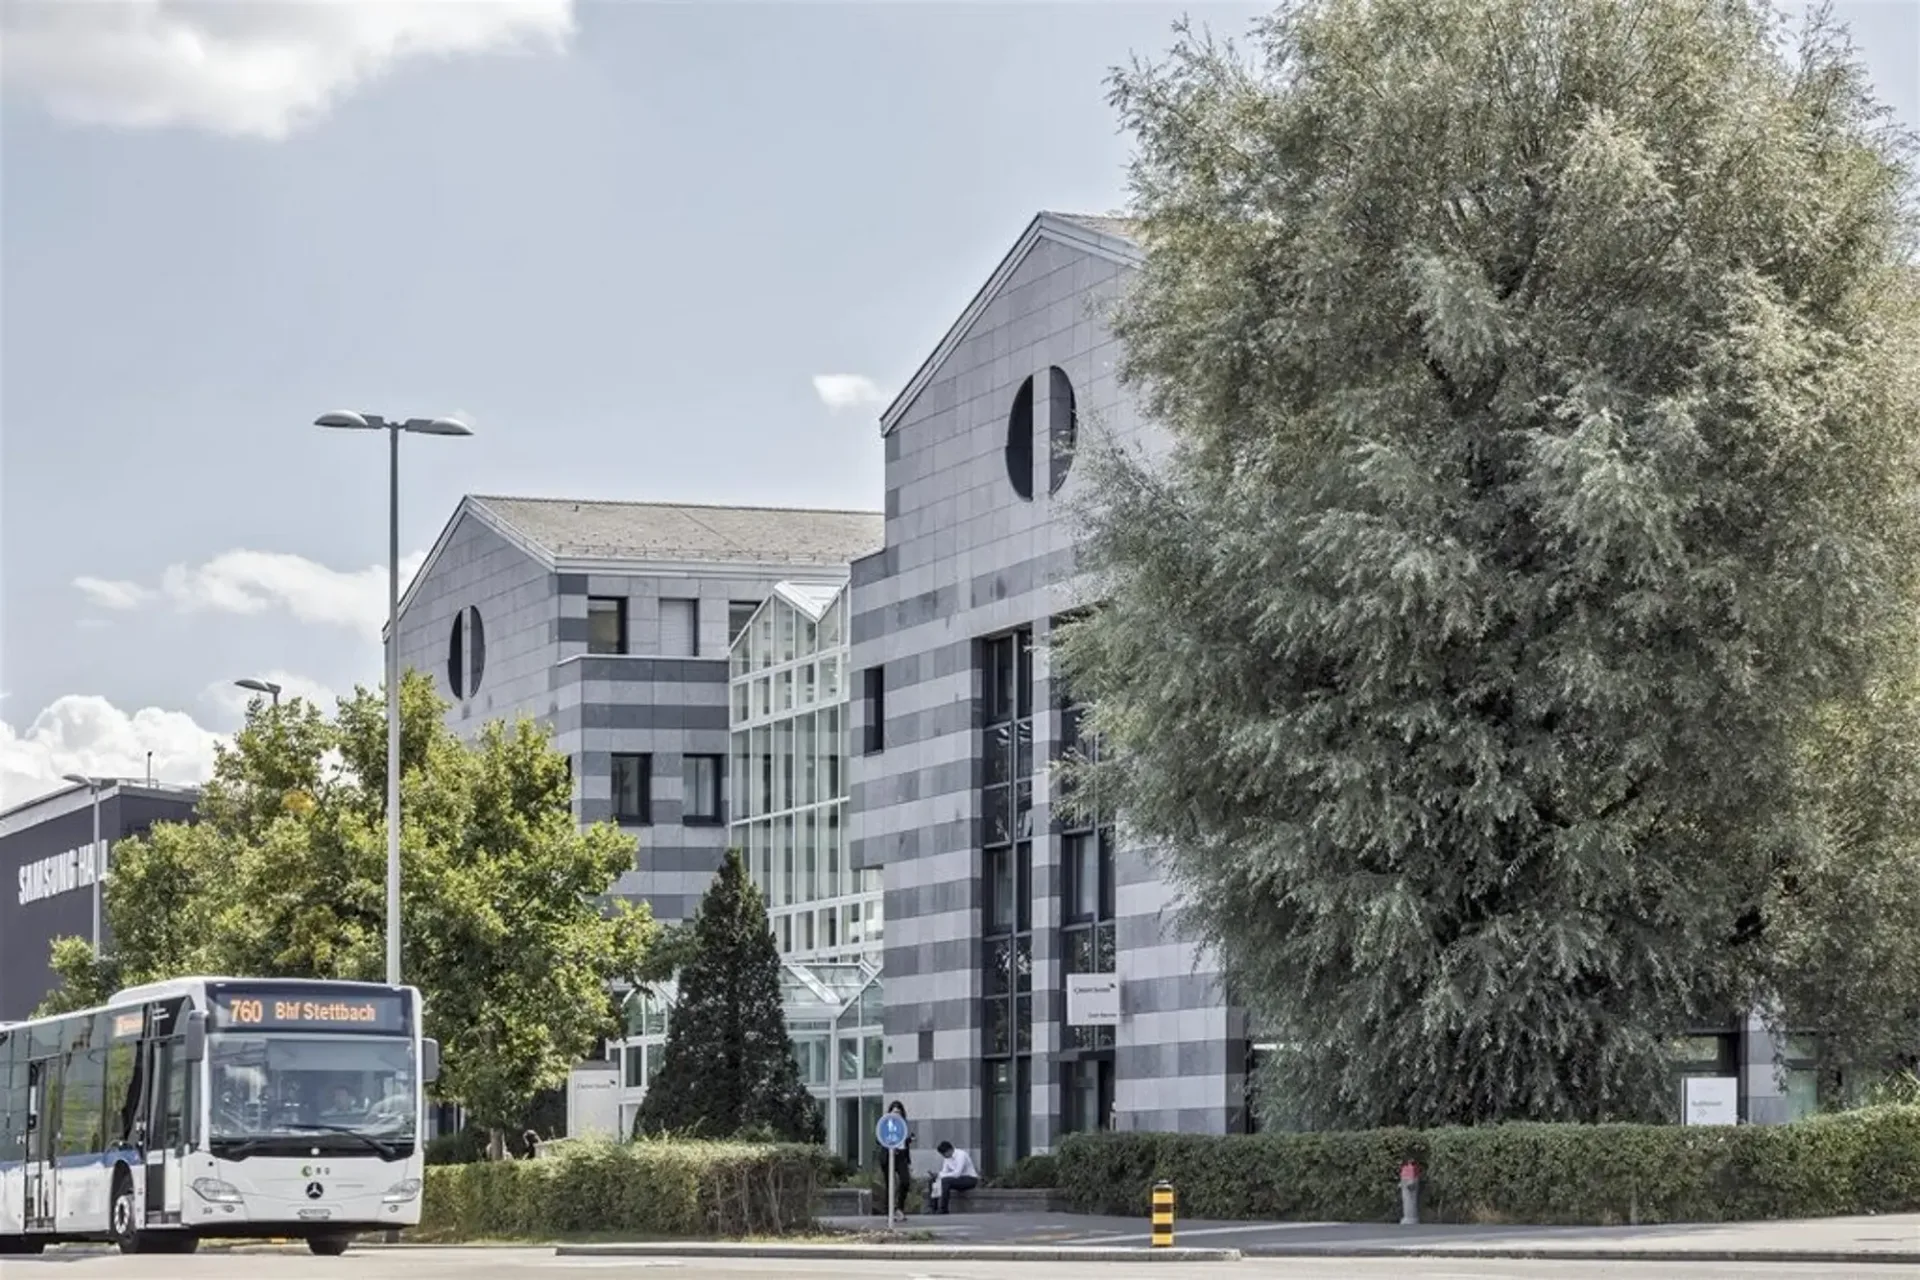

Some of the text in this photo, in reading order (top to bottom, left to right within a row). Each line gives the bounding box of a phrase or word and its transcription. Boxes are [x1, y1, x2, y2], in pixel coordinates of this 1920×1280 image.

[230, 999, 376, 1023] 760 Bhf Stettbach
